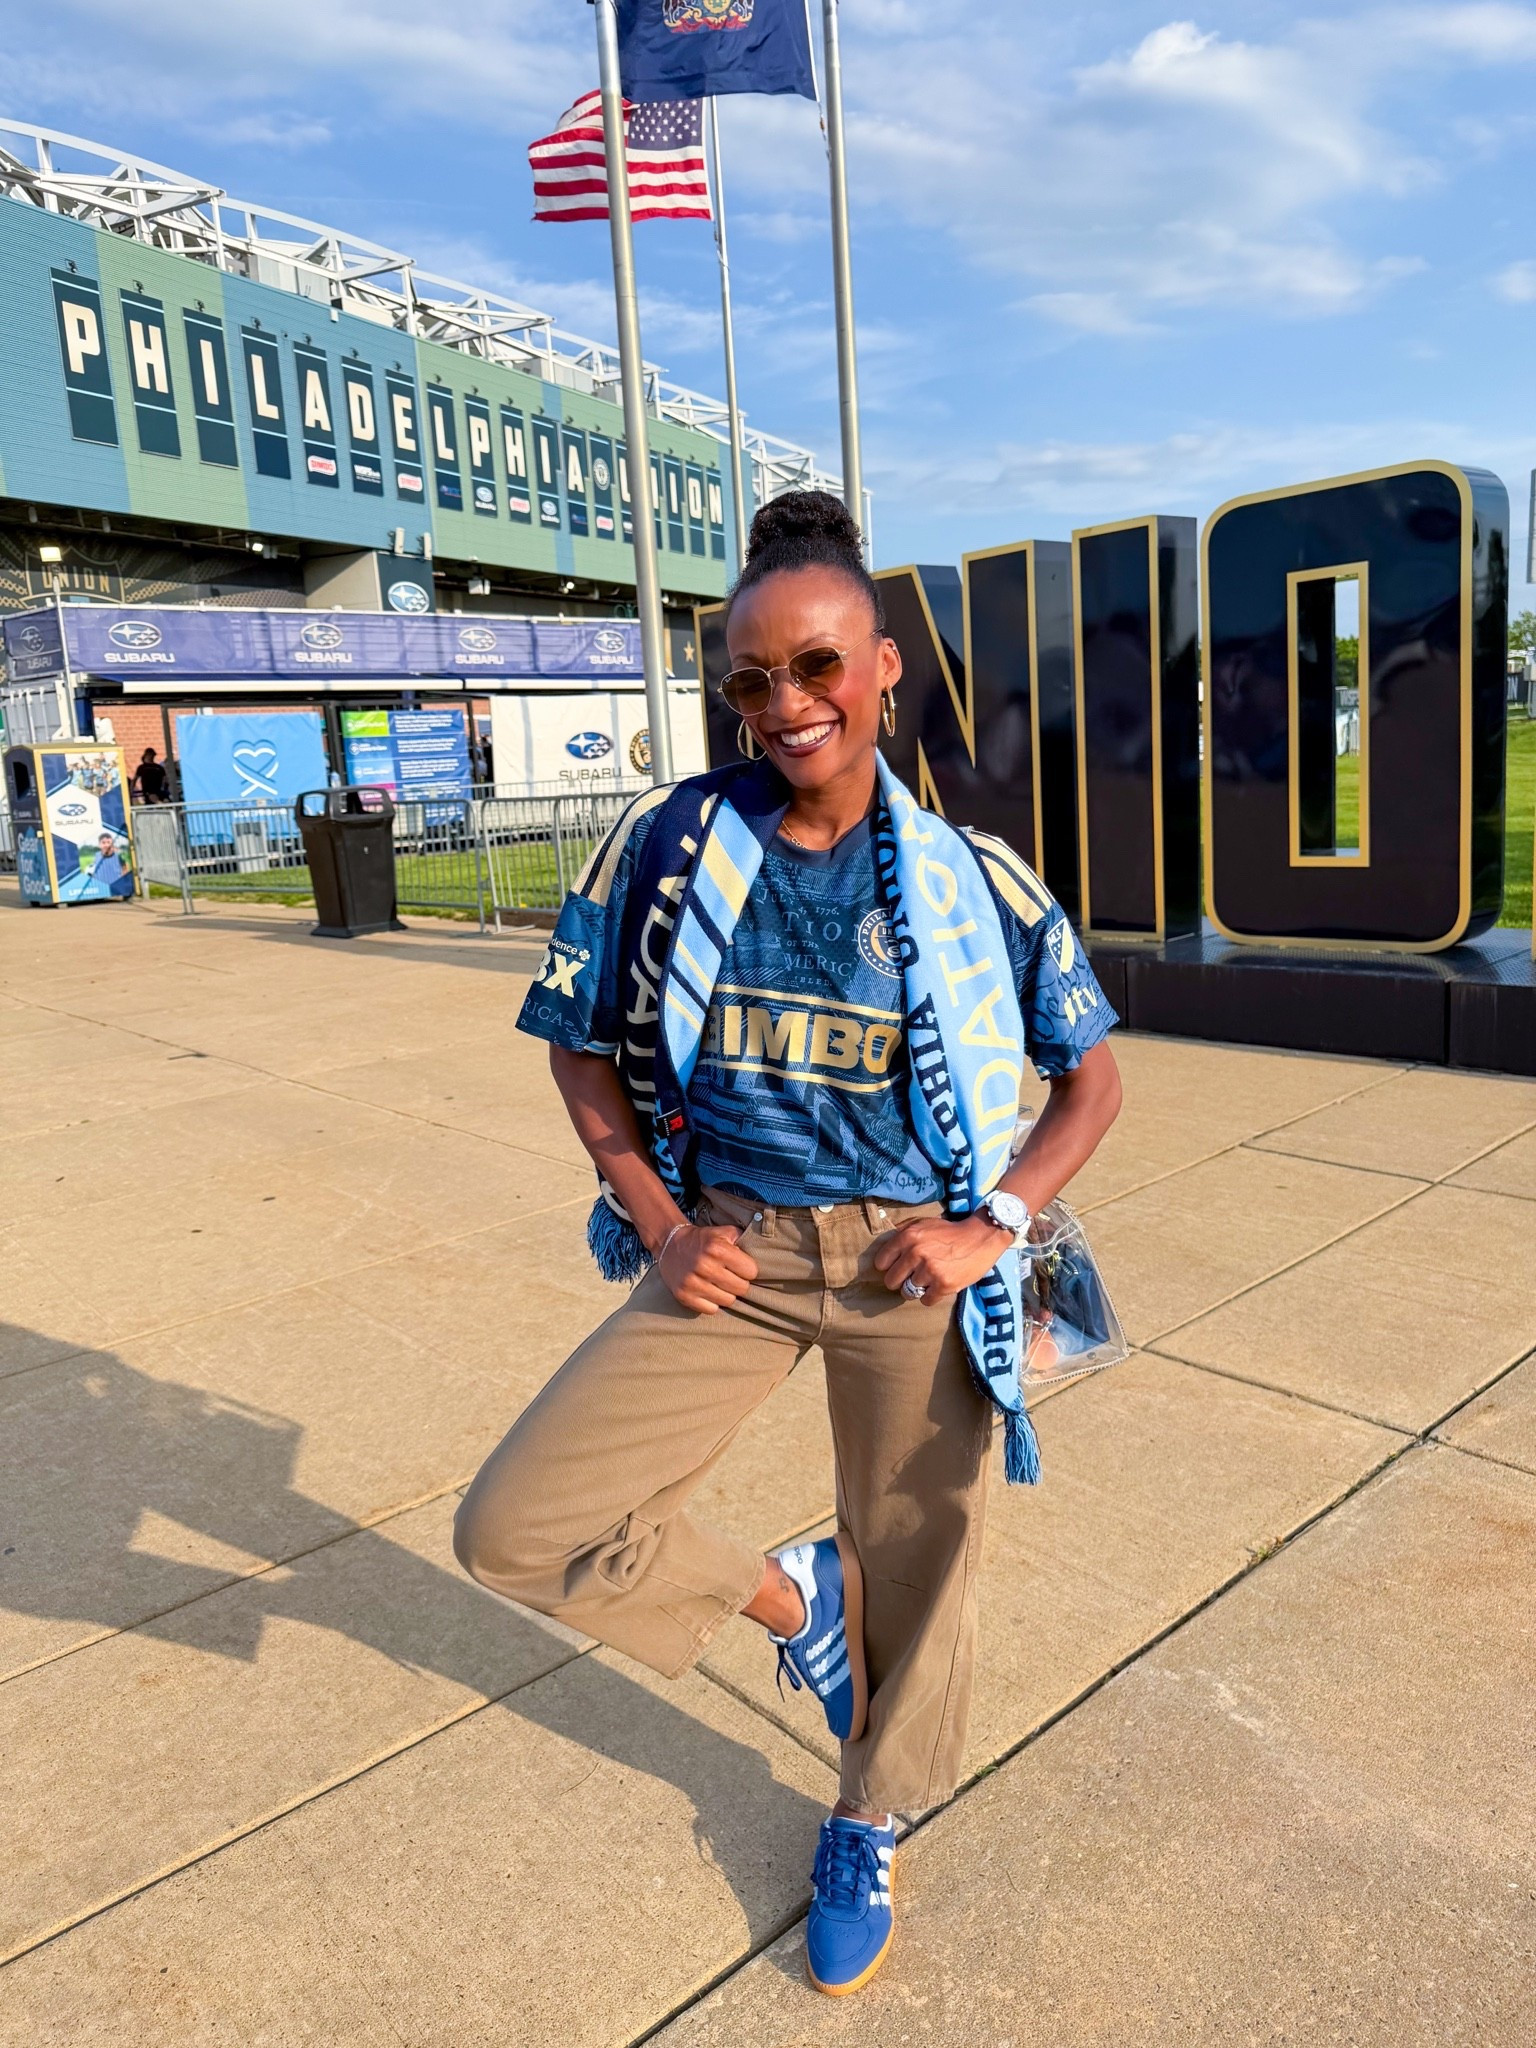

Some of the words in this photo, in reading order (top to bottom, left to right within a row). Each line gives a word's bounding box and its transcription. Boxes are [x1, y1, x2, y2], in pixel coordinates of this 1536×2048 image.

[61, 300, 586, 494] PHILADELPHIA
[104, 652, 175, 664] SUBARU
[294, 651, 353, 663] SUBARU
[454, 653, 505, 665] SUBARU
[589, 653, 635, 666] SUBARU
[558, 767, 622, 781] SUBARU
[54, 818, 94, 827] SUBARU
[1048, 929, 1062, 946] MLS
